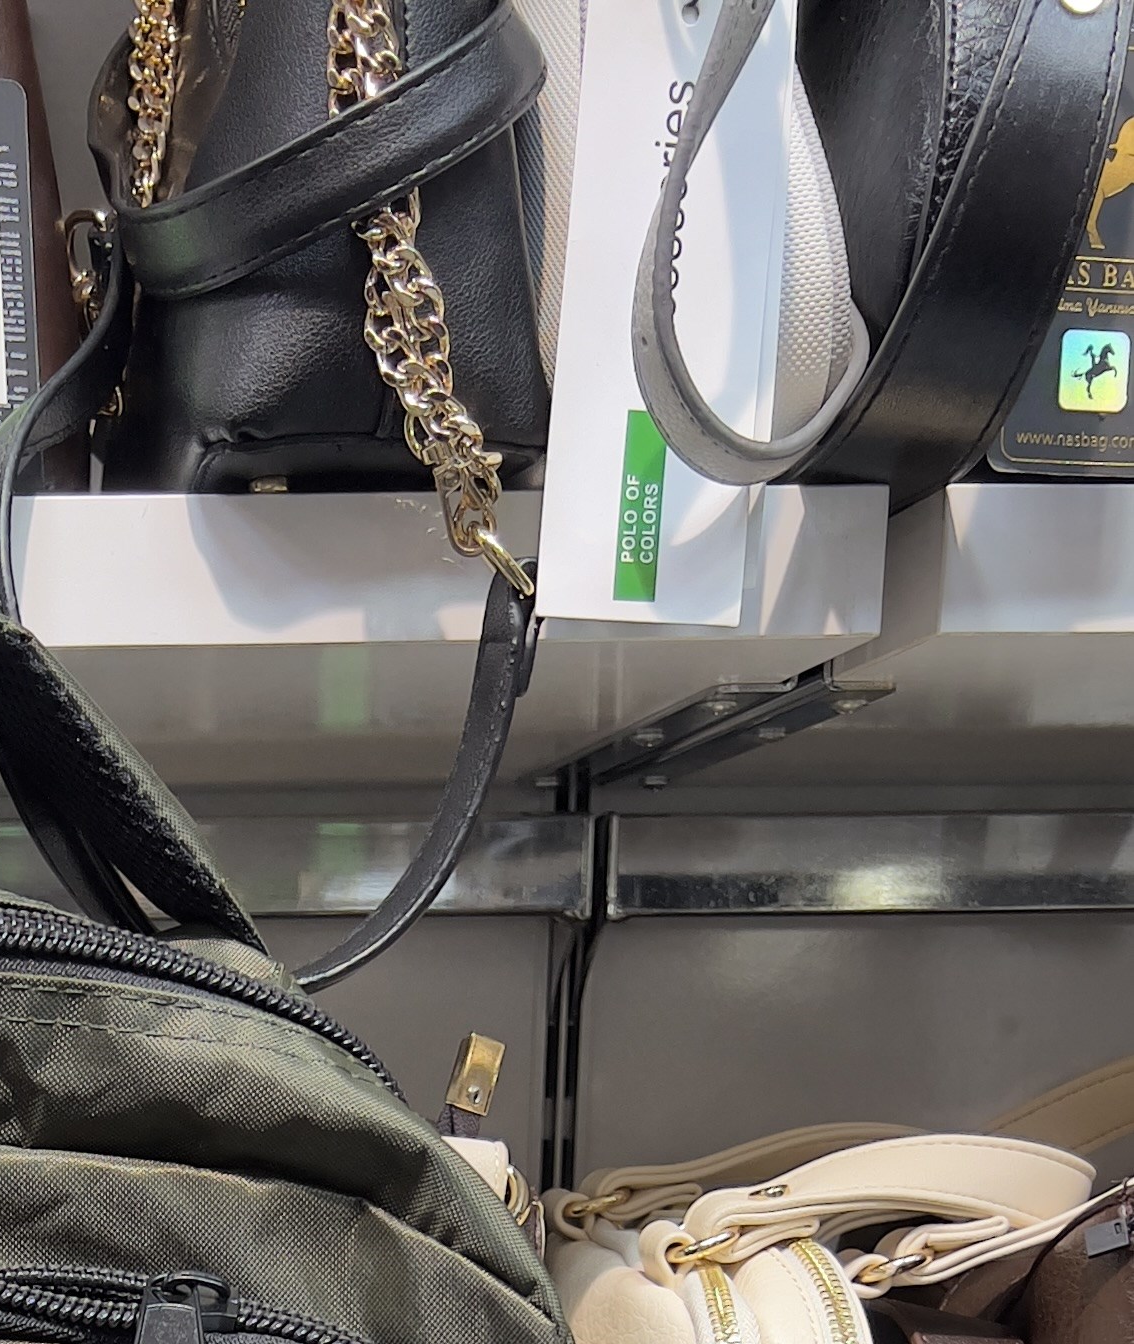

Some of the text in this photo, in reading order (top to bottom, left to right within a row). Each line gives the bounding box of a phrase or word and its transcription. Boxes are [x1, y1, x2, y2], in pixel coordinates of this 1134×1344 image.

[620, 474, 641, 563] POLO OF
[639, 483, 659, 564] COLORS
